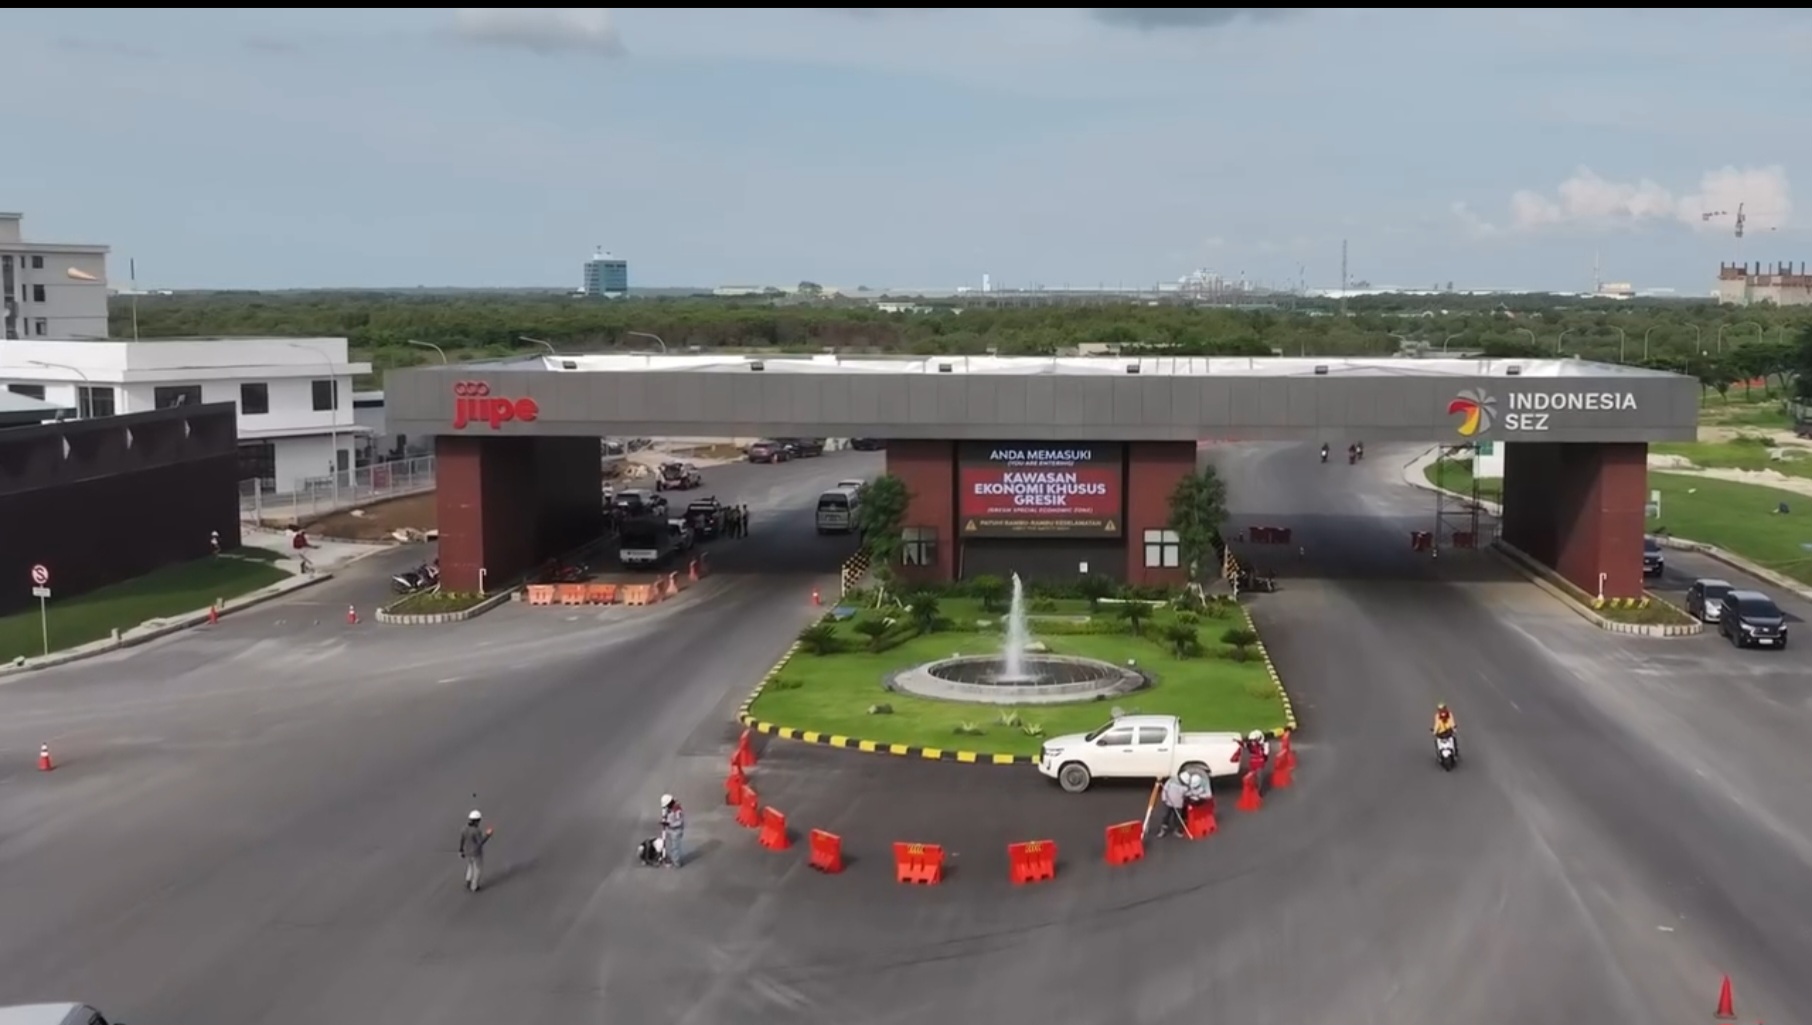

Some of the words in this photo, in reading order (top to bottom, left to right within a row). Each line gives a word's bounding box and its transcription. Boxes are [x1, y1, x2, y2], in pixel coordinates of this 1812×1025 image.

[1509, 392, 1637, 410] INDONESIA
[1505, 413, 1549, 431] SEZ
[990, 449, 1025, 460] ANDA
[1027, 449, 1091, 460] MEMASUKI
[1003, 473, 1076, 483] KAWASAN
[974, 484, 1043, 494] EKONOMI
[1047, 484, 1106, 494] KHUSUS
[1014, 495, 1067, 505] GRESIK
